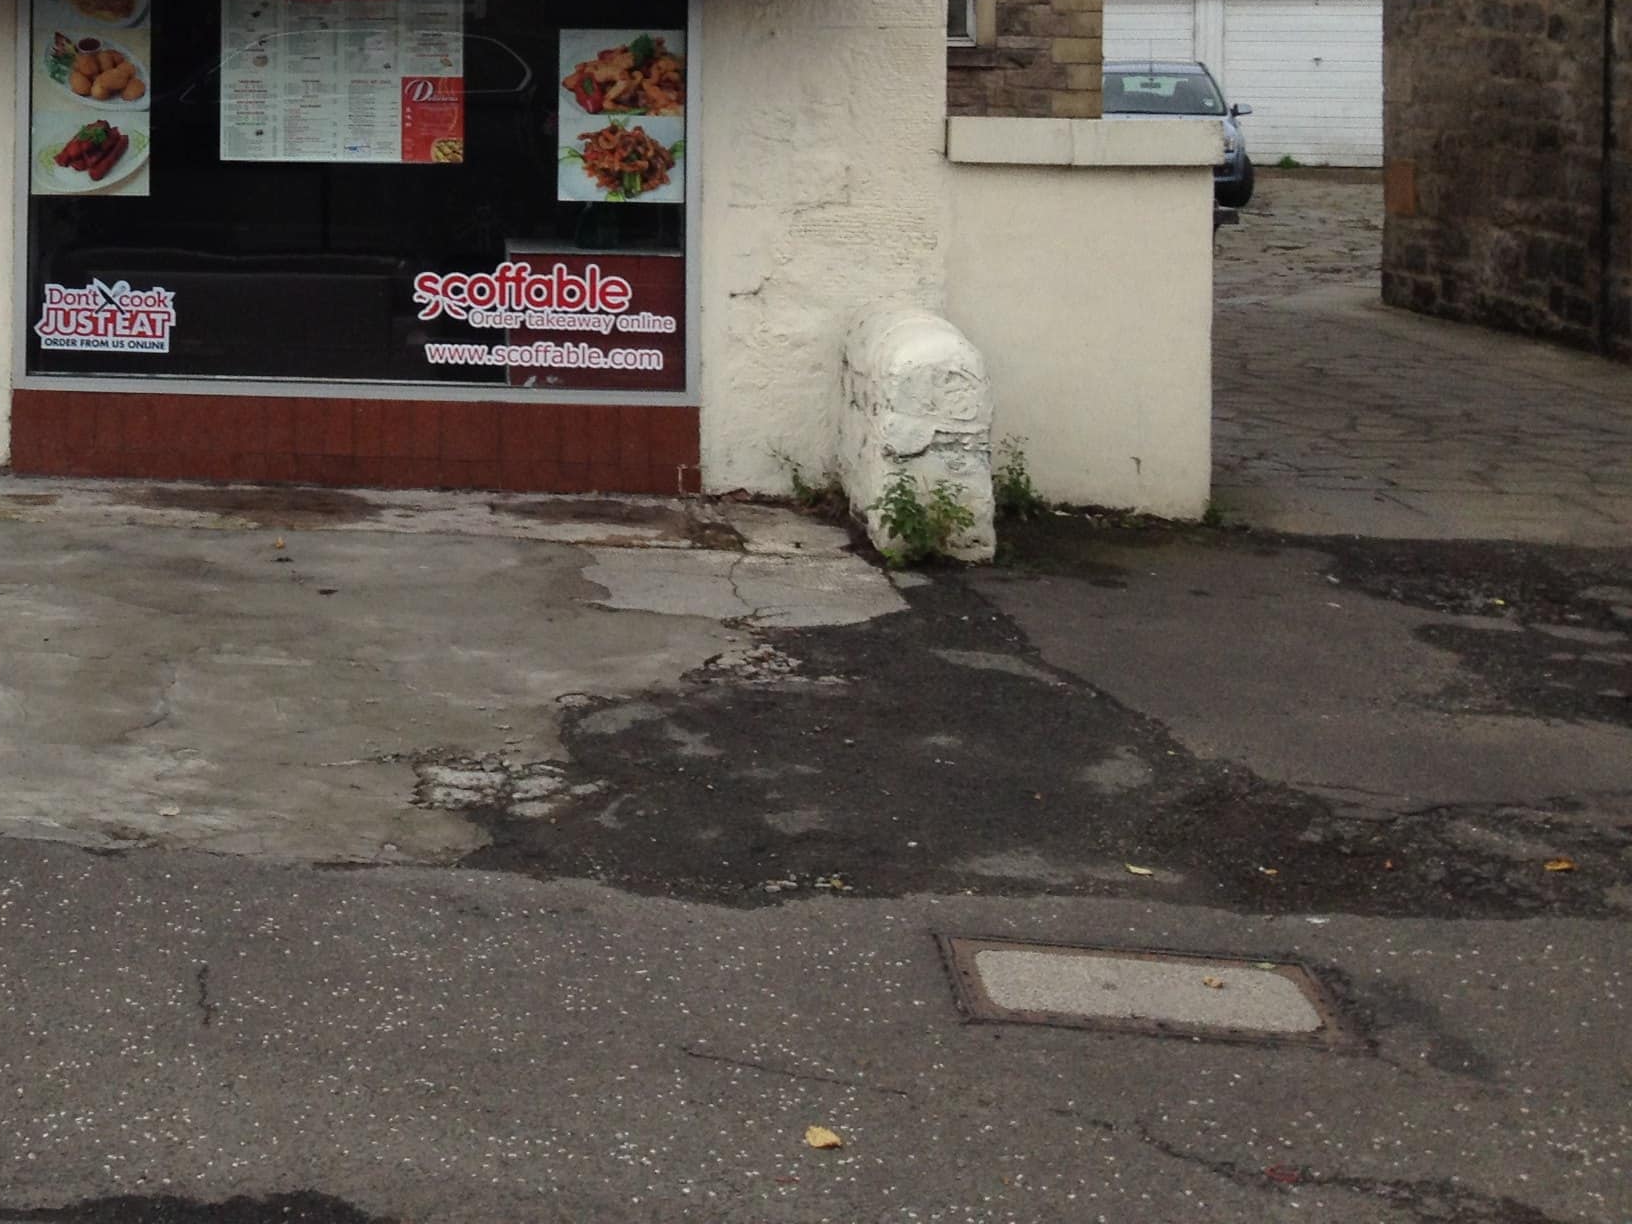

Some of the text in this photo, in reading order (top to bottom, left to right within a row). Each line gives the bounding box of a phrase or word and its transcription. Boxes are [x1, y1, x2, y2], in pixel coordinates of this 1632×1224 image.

[48, 287, 169, 308] Don't cook
[415, 264, 631, 313] scoffable
[40, 309, 169, 337] JUST EAT
[470, 310, 675, 334] Order takeaway online
[44, 338, 165, 351] ORDER FROM US ONLINE
[426, 343, 662, 369] www.scoffable.com
